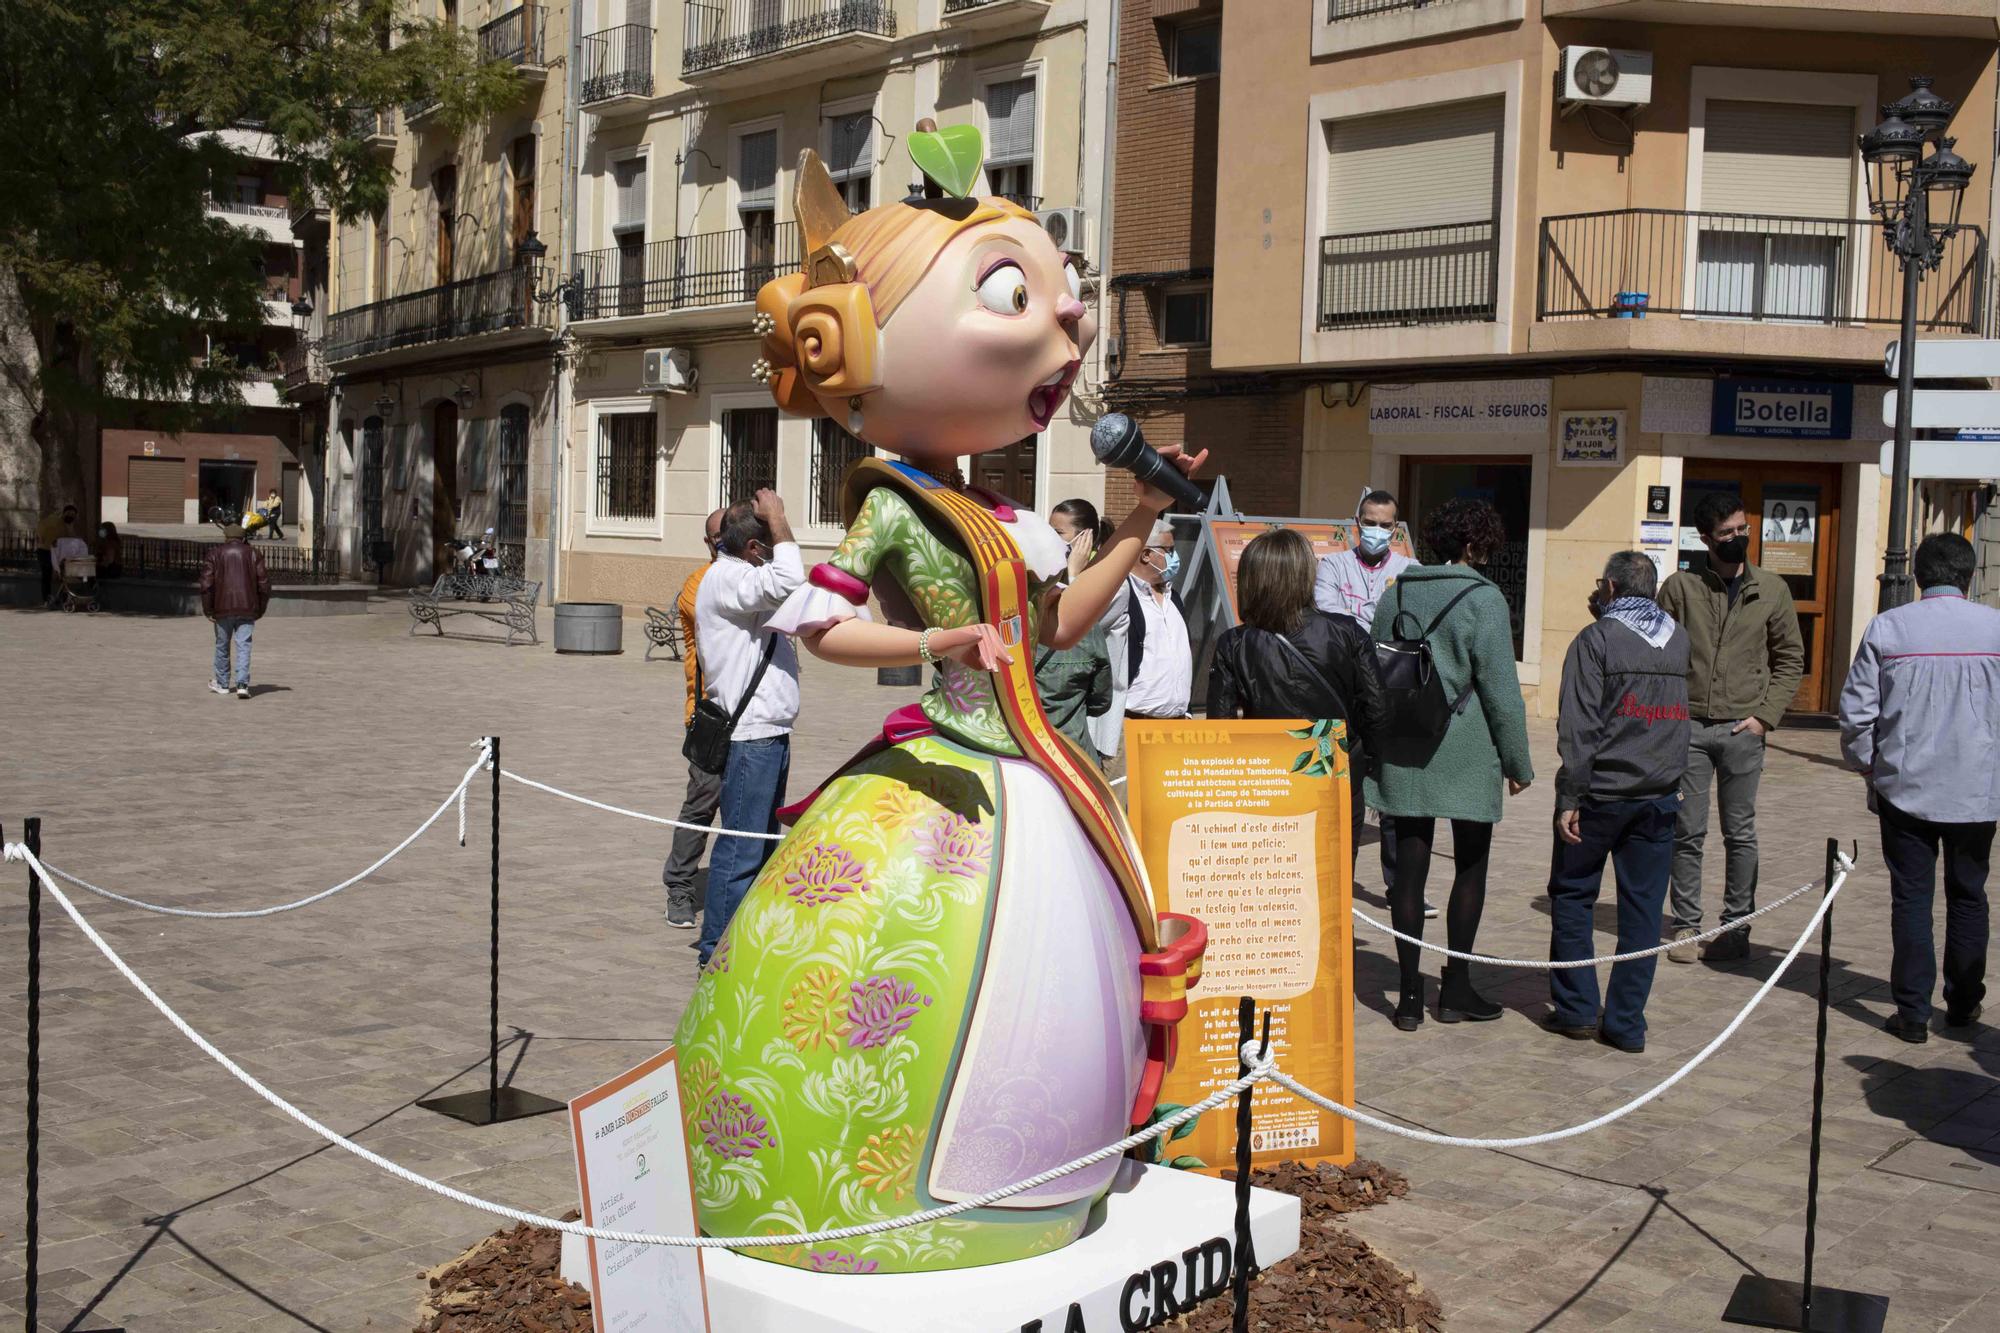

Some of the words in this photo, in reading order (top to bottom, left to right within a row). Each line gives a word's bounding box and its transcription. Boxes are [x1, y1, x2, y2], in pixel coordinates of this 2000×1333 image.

[1370, 407, 1421, 420] LABORAL
[1434, 406, 1474, 418] FISCAL
[1488, 404, 1548, 418] SEGUROS
[1738, 398, 1828, 422] Botella
[1140, 729, 1165, 745] LA
[1171, 729, 1232, 744] CRIDA
[1237, 757, 1246, 765] de
[1249, 757, 1270, 765] sabor
[1181, 768, 1191, 776] du
[1194, 768, 1201, 776] la
[1204, 767, 1244, 776] Mandarina
[1247, 767, 1289, 776] Tamborina,
[1163, 779, 1194, 787] varietat
[1238, 778, 1292, 787] carcaixentina,
[1167, 789, 1203, 797] cultivada
[1206, 789, 1213, 797] al
[1216, 789, 1238, 799] Camp
[1253, 788, 1289, 796] Tambores
[1195, 800, 1202, 808] la
[1205, 800, 1234, 808] Partida
[1204, 823, 1237, 834] vehinat
[1272, 822, 1299, 832] distrit
[1200, 839, 1206, 849] li
[1209, 840, 1227, 849] fem
[1231, 841, 1248, 849] una
[1216, 855, 1249, 866] disapte
[1253, 855, 1269, 865] per
[1273, 855, 1282, 864] la
[1286, 854, 1297, 863] nit
[1182, 872, 1206, 884] tinga
[1250, 870, 1264, 880] els
[1185, 888, 1203, 899] fent
[1190, 906, 1201, 914] en
[1206, 904, 1236, 915] festeig
[1240, 904, 1255, 912] tan
[1214, 920, 1231, 929] una
[1235, 919, 1257, 929] volta
[1261, 918, 1270, 927] al
[1274, 918, 1302, 927] menos
[1246, 932, 1264, 942] eixe
[1220, 953, 1241, 961] casa
[1245, 951, 1257, 960] no
[1215, 969, 1231, 977] nos
[1234, 965, 1266, 977] reimos
[1199, 1009, 1209, 1018] La
[1222, 1008, 1231, 1016] de
[1204, 1020, 1213, 1029] de
[1210, 1032, 1219, 1040] va
[1200, 1044, 1214, 1053] dels
[1216, 1043, 1231, 1053] peus
[1213, 1067, 1223, 1075] La
[1266, 1086, 1284, 1094] falles
[1270, 1096, 1294, 1105] carrer
[601, 1122, 615, 1137] AMB
[616, 1116, 626, 1129] LES
[651, 1090, 669, 1108] FALLES
[599, 1192, 624, 1212] Artista
[618, 1200, 637, 1218] Oliver
[606, 1254, 633, 1276] Cristian
